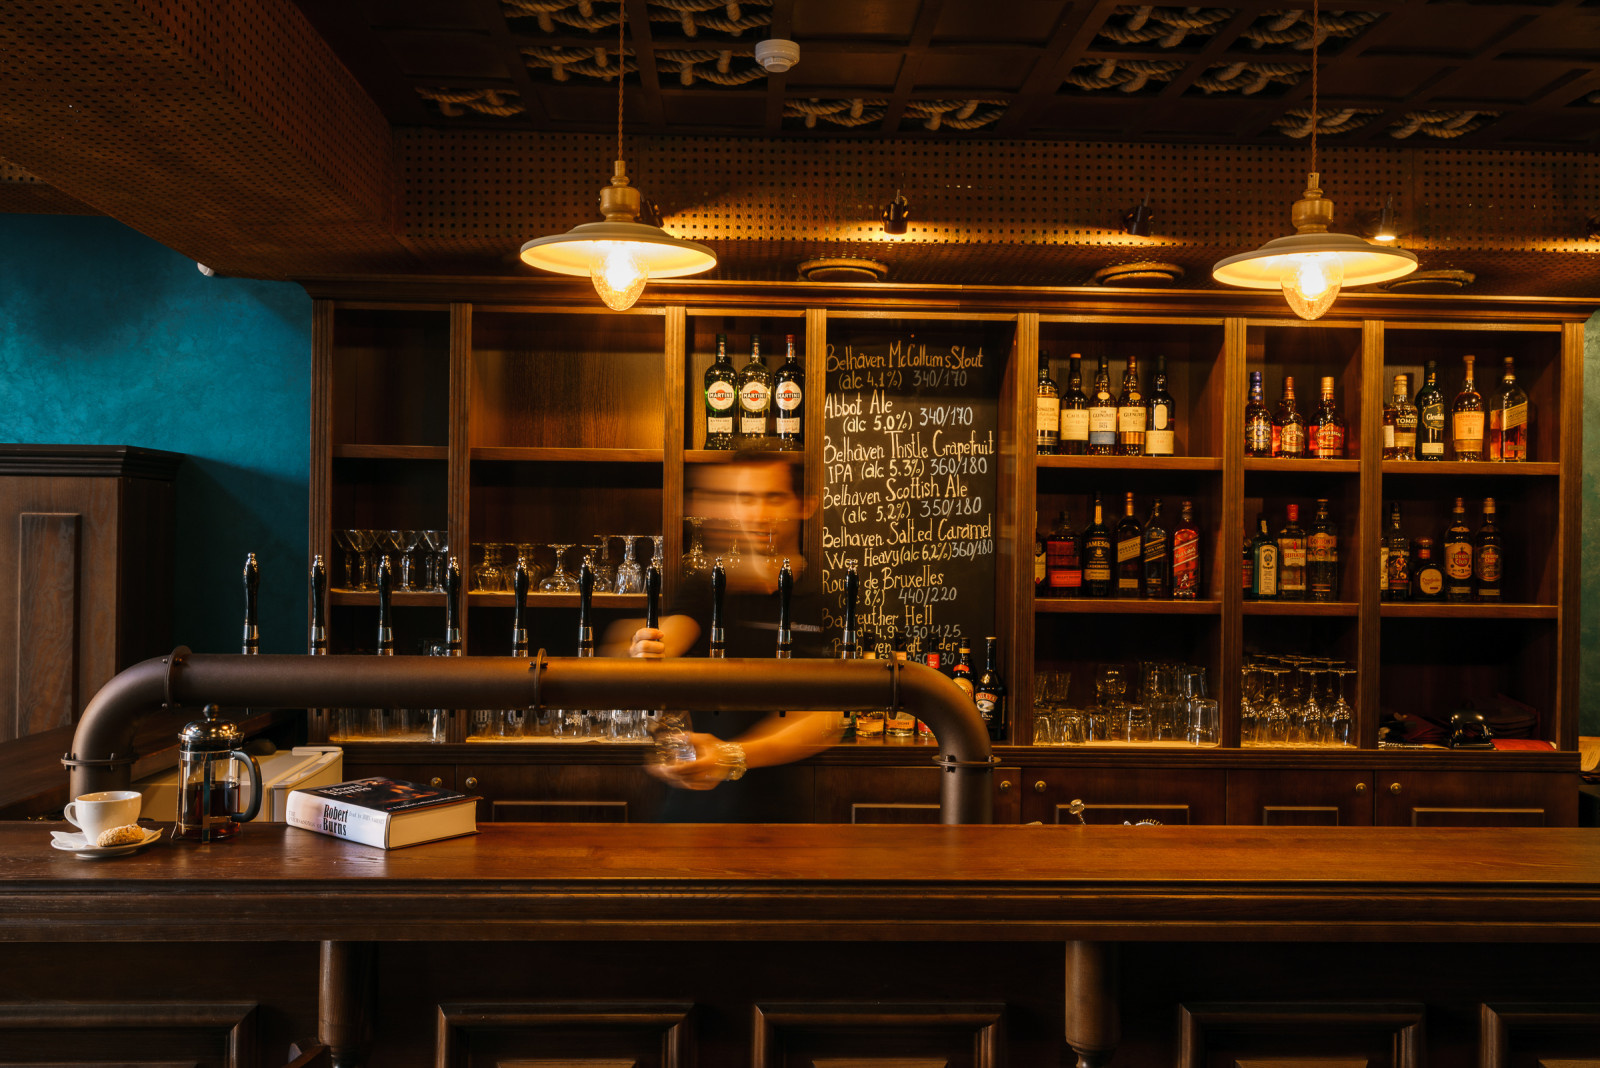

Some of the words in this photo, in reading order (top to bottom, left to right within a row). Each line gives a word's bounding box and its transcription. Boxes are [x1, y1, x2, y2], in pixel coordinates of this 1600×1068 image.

[826, 344, 886, 372] Belhaven
[951, 345, 984, 370] Stout
[838, 370, 864, 390] (alc
[912, 369, 968, 388] 340/170
[824, 392, 863, 419] Abbot
[870, 389, 893, 414] Ale
[843, 416, 867, 434] (alc
[919, 406, 973, 426] 340/170
[823, 435, 885, 464] Belhaven
[884, 430, 928, 459] Thistle
[932, 430, 995, 461] Grapefruit
[828, 463, 853, 484] IPA
[861, 461, 885, 480] (alc
[930, 457, 987, 477] 360/180
[823, 485, 880, 510] Belhaven
[886, 476, 940, 503] Scottish
[944, 474, 968, 498] Ale
[842, 507, 867, 525] (alc
[919, 496, 982, 518] 350/180
[823, 526, 884, 548] Belhaven
[886, 518, 933, 545] Salted
[938, 513, 992, 541] Caramel
[863, 547, 900, 567] Heavy
[951, 539, 993, 561] 360/180
[822, 569, 860, 594] Rou
[864, 571, 879, 590] de
[881, 566, 944, 590] Bruxelles
[898, 587, 958, 607] 440/220
[905, 605, 933, 626] Hell
[323, 804, 348, 823] Robert
[323, 817, 347, 836] Burns
